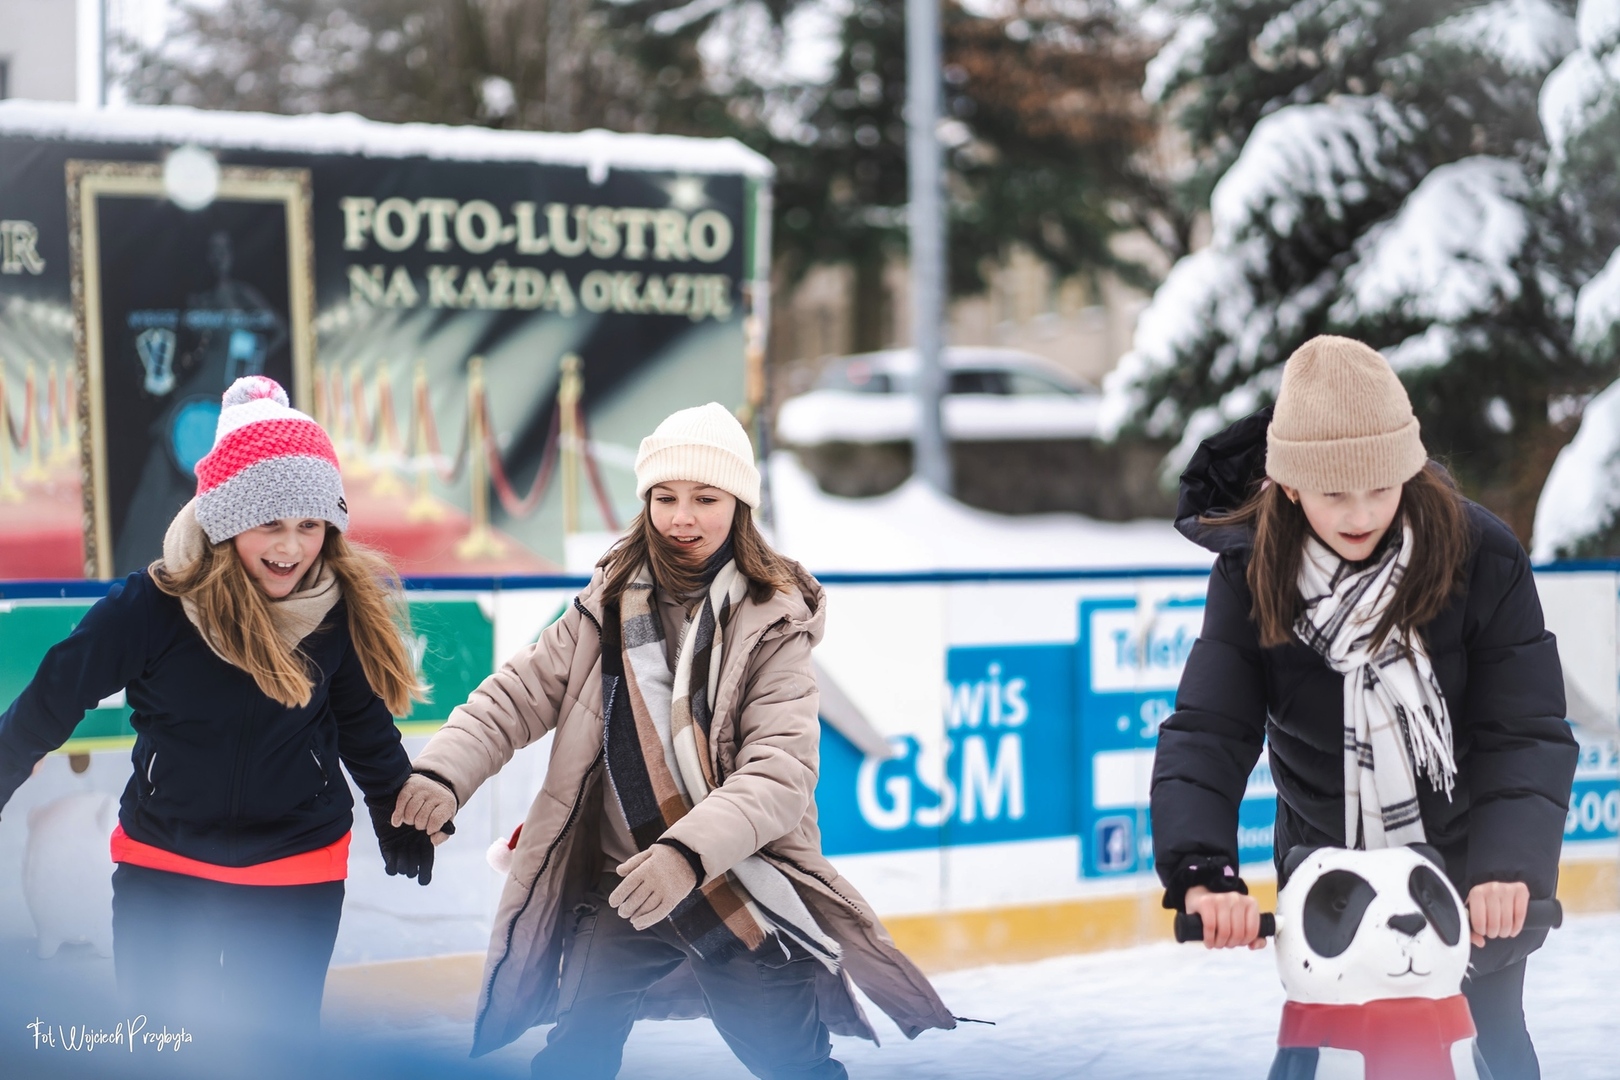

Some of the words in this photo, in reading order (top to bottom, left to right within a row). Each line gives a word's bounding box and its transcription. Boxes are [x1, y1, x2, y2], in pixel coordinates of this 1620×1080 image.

[341, 196, 733, 263] FOTO-LUSTRO
[347, 264, 420, 309] NA
[427, 260, 578, 317] KAŻDĄ
[580, 269, 733, 322] OKAZJĘ
[855, 731, 1027, 832] GSM
